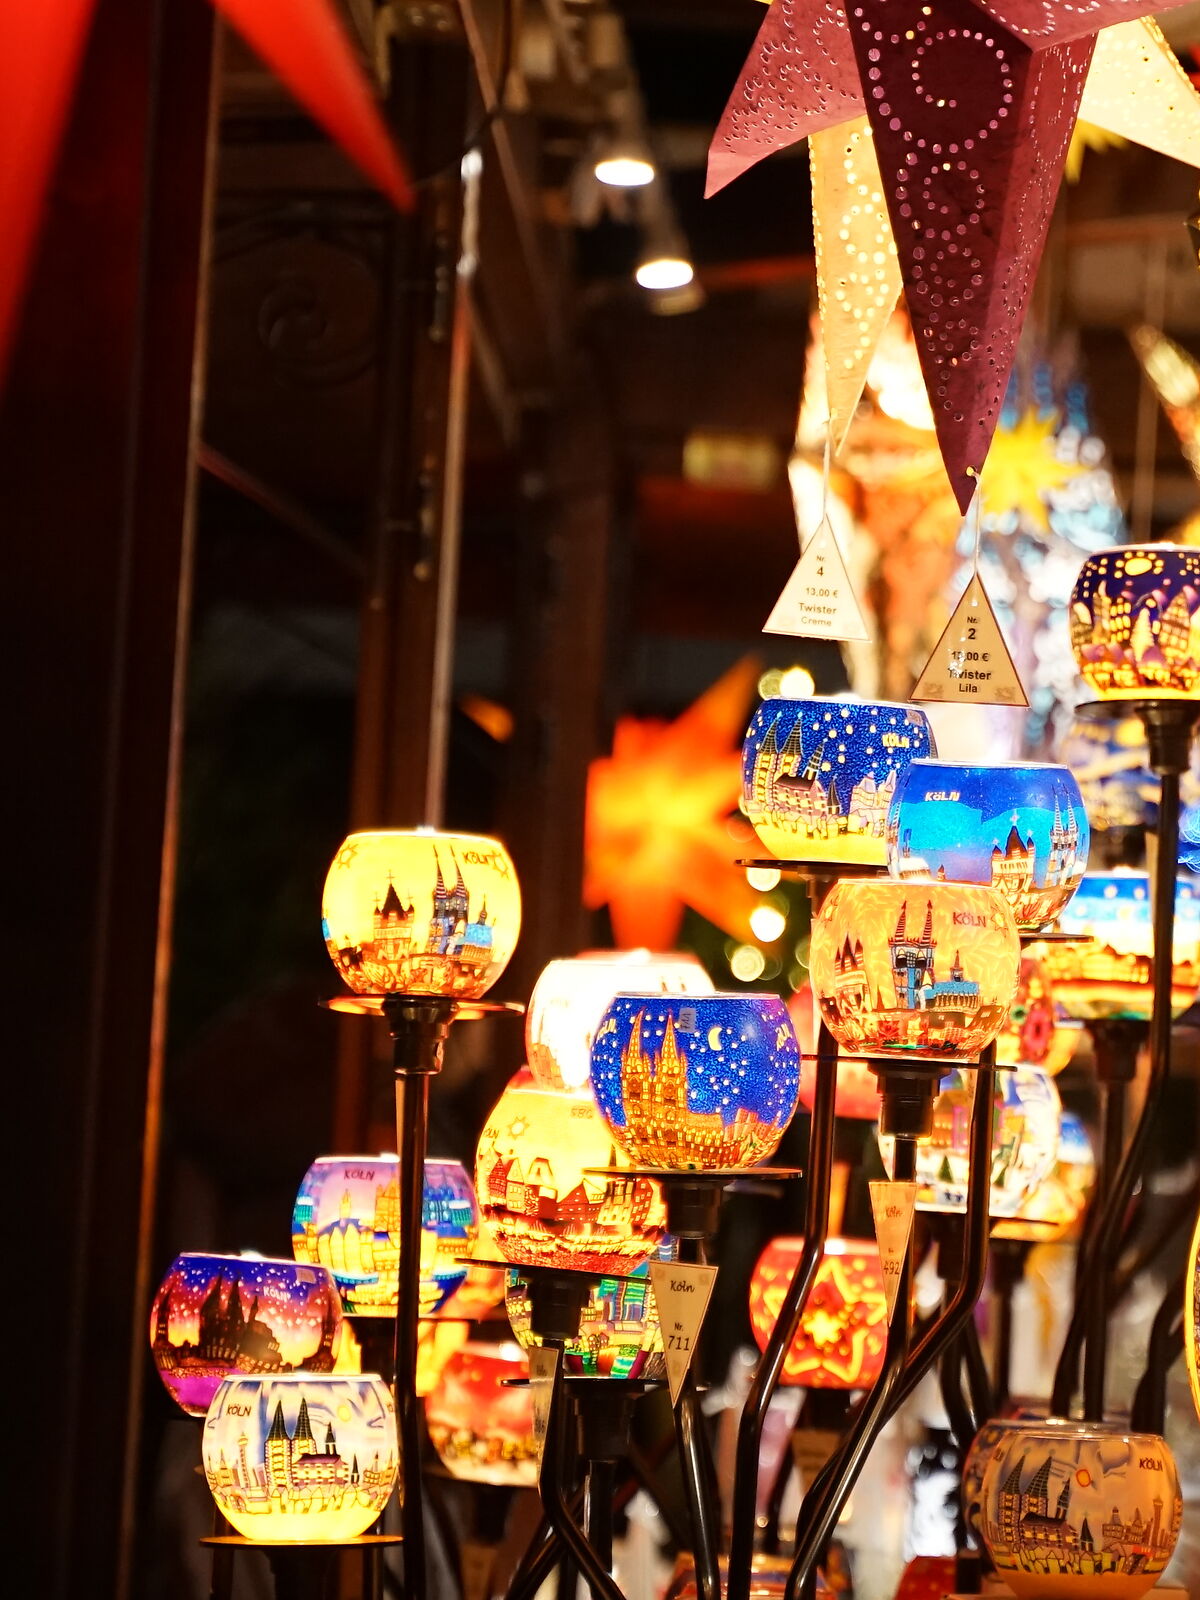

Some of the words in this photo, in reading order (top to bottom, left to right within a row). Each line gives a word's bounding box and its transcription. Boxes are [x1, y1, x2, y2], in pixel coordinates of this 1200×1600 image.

[816, 566, 824, 576] 4
[798, 602, 837, 614] Twister
[801, 616, 832, 627] Creme
[968, 628, 976, 640] 2
[982, 652, 990, 661] €
[959, 683, 978, 693] Lila
[953, 912, 986, 928] KÖLN
[670, 1280, 695, 1293] Köln
[668, 1335, 690, 1351] 711
